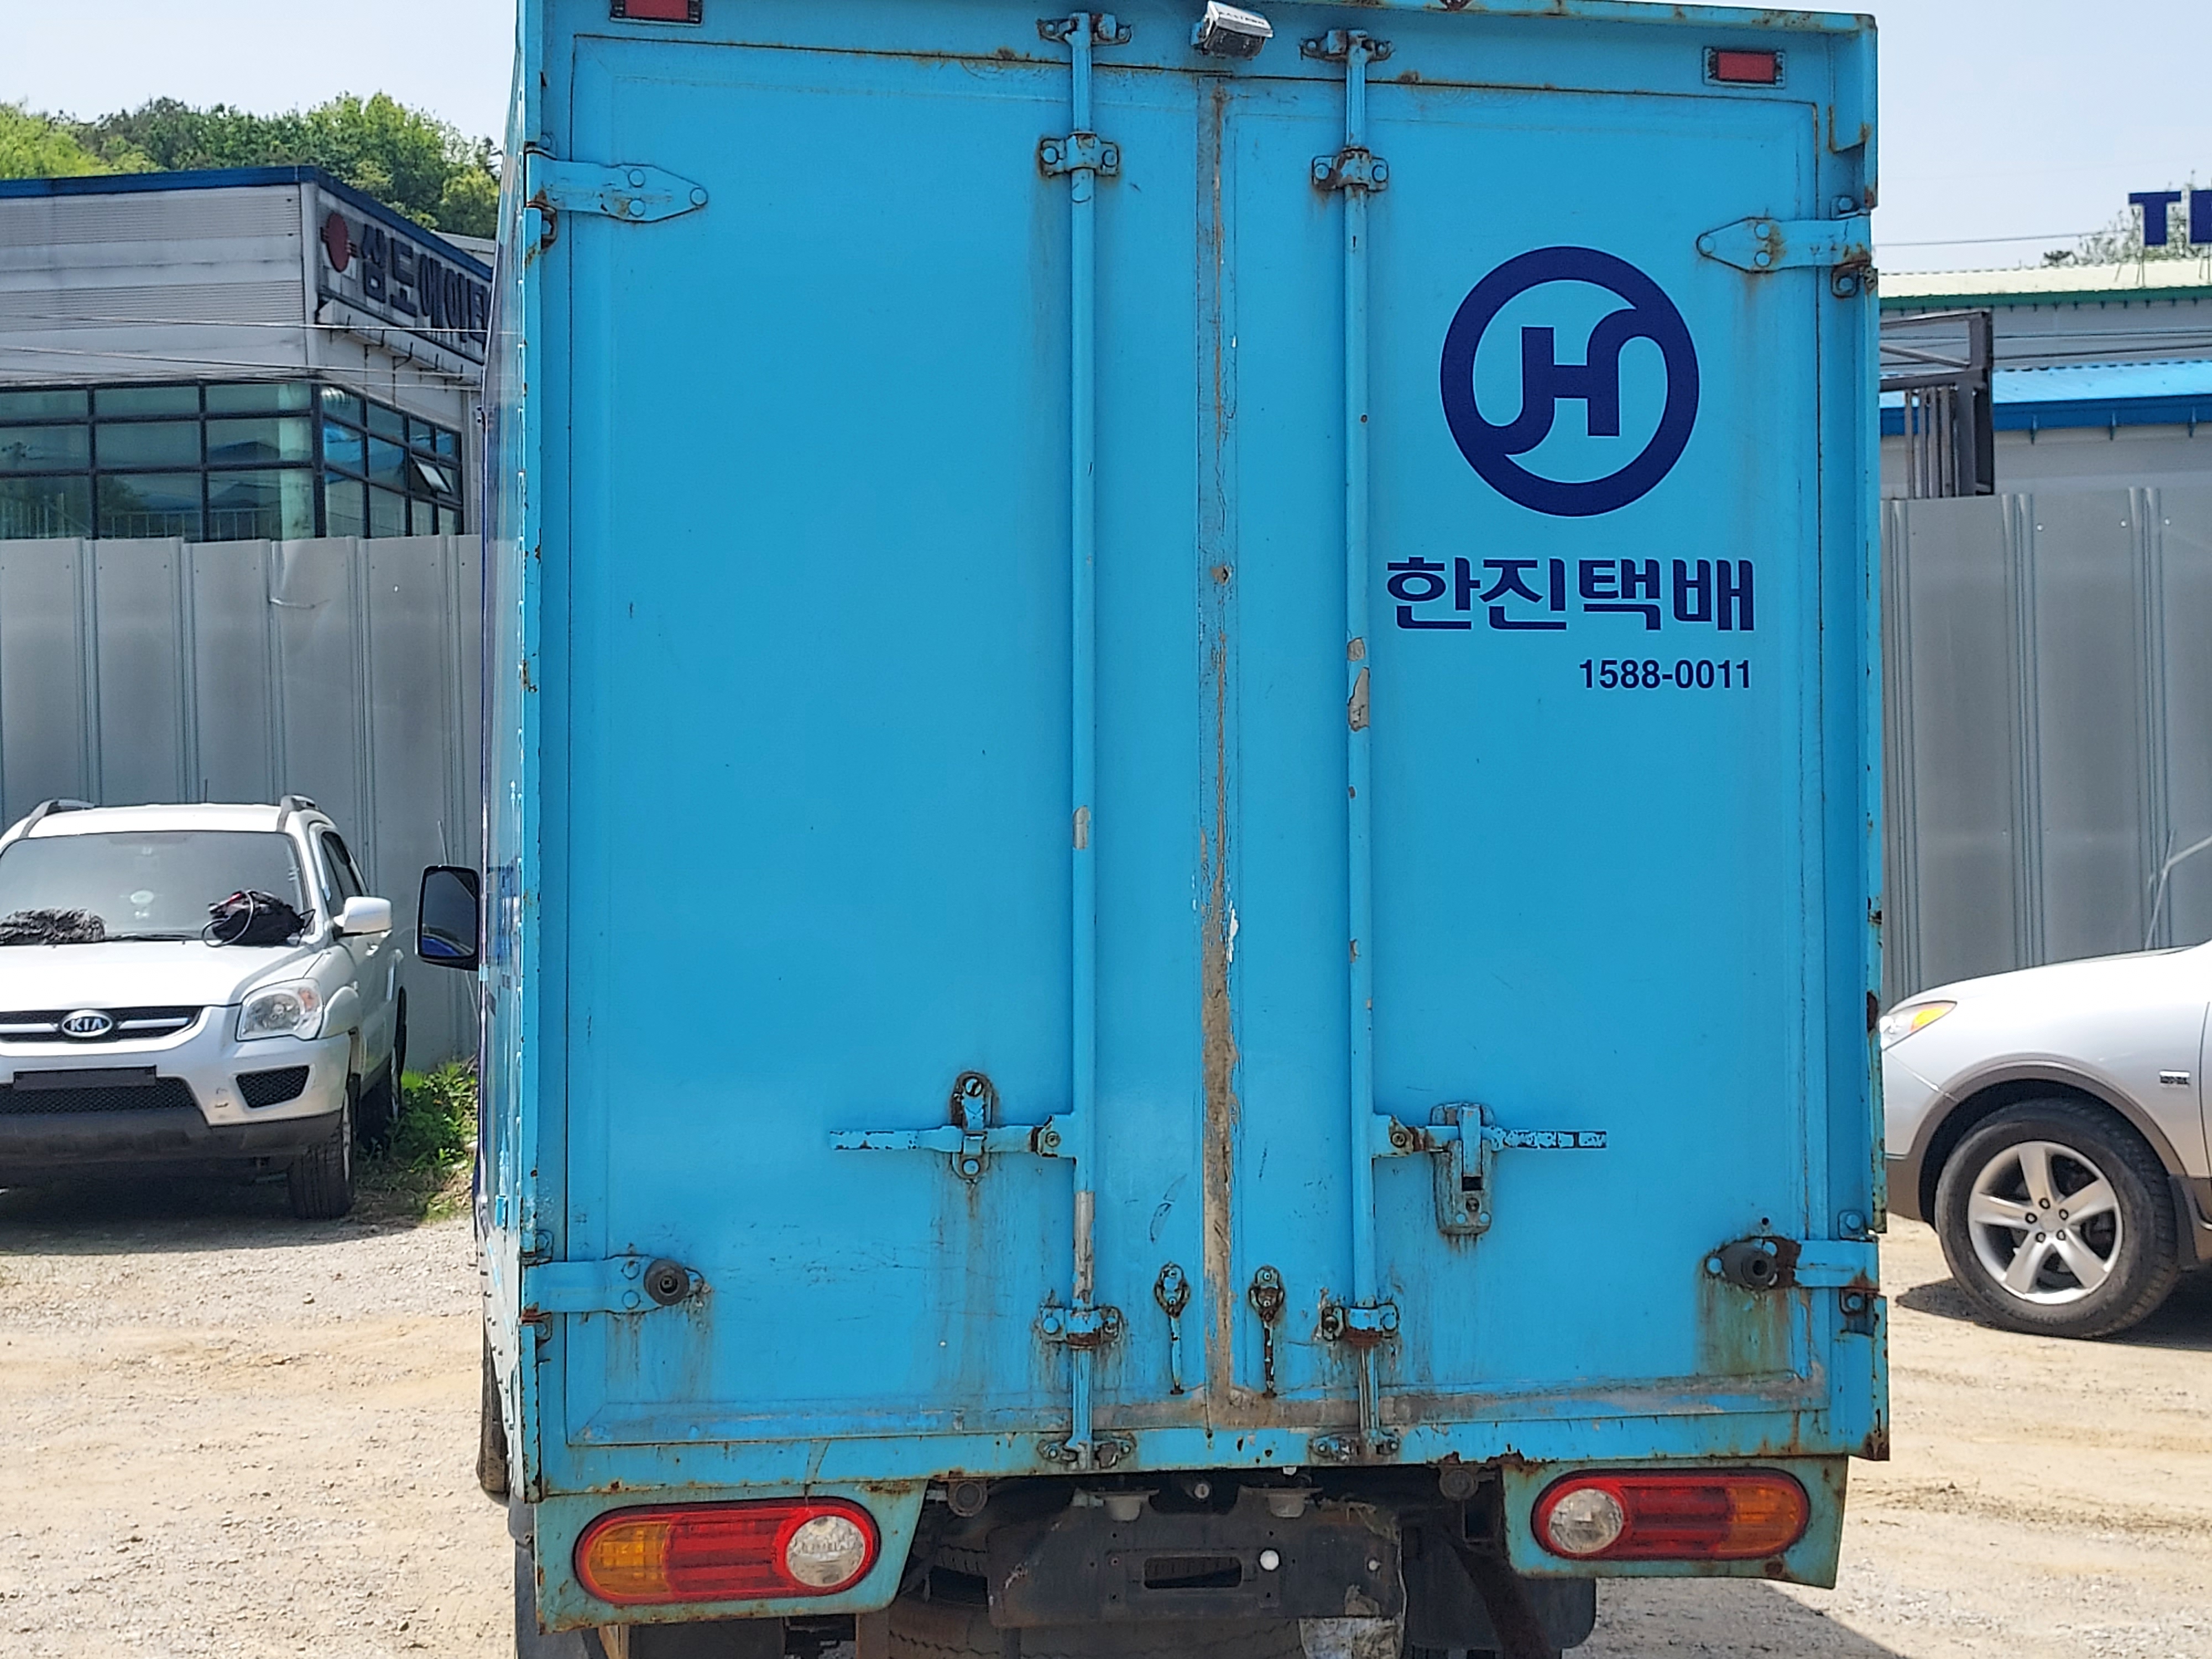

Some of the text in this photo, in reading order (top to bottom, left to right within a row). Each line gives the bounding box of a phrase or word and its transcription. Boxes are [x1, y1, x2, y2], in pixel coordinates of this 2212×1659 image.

[1387, 556, 1754, 631] 한진택배
[1579, 659, 1750, 688] 1588-0011
[71, 1018, 103, 1031] KIA
